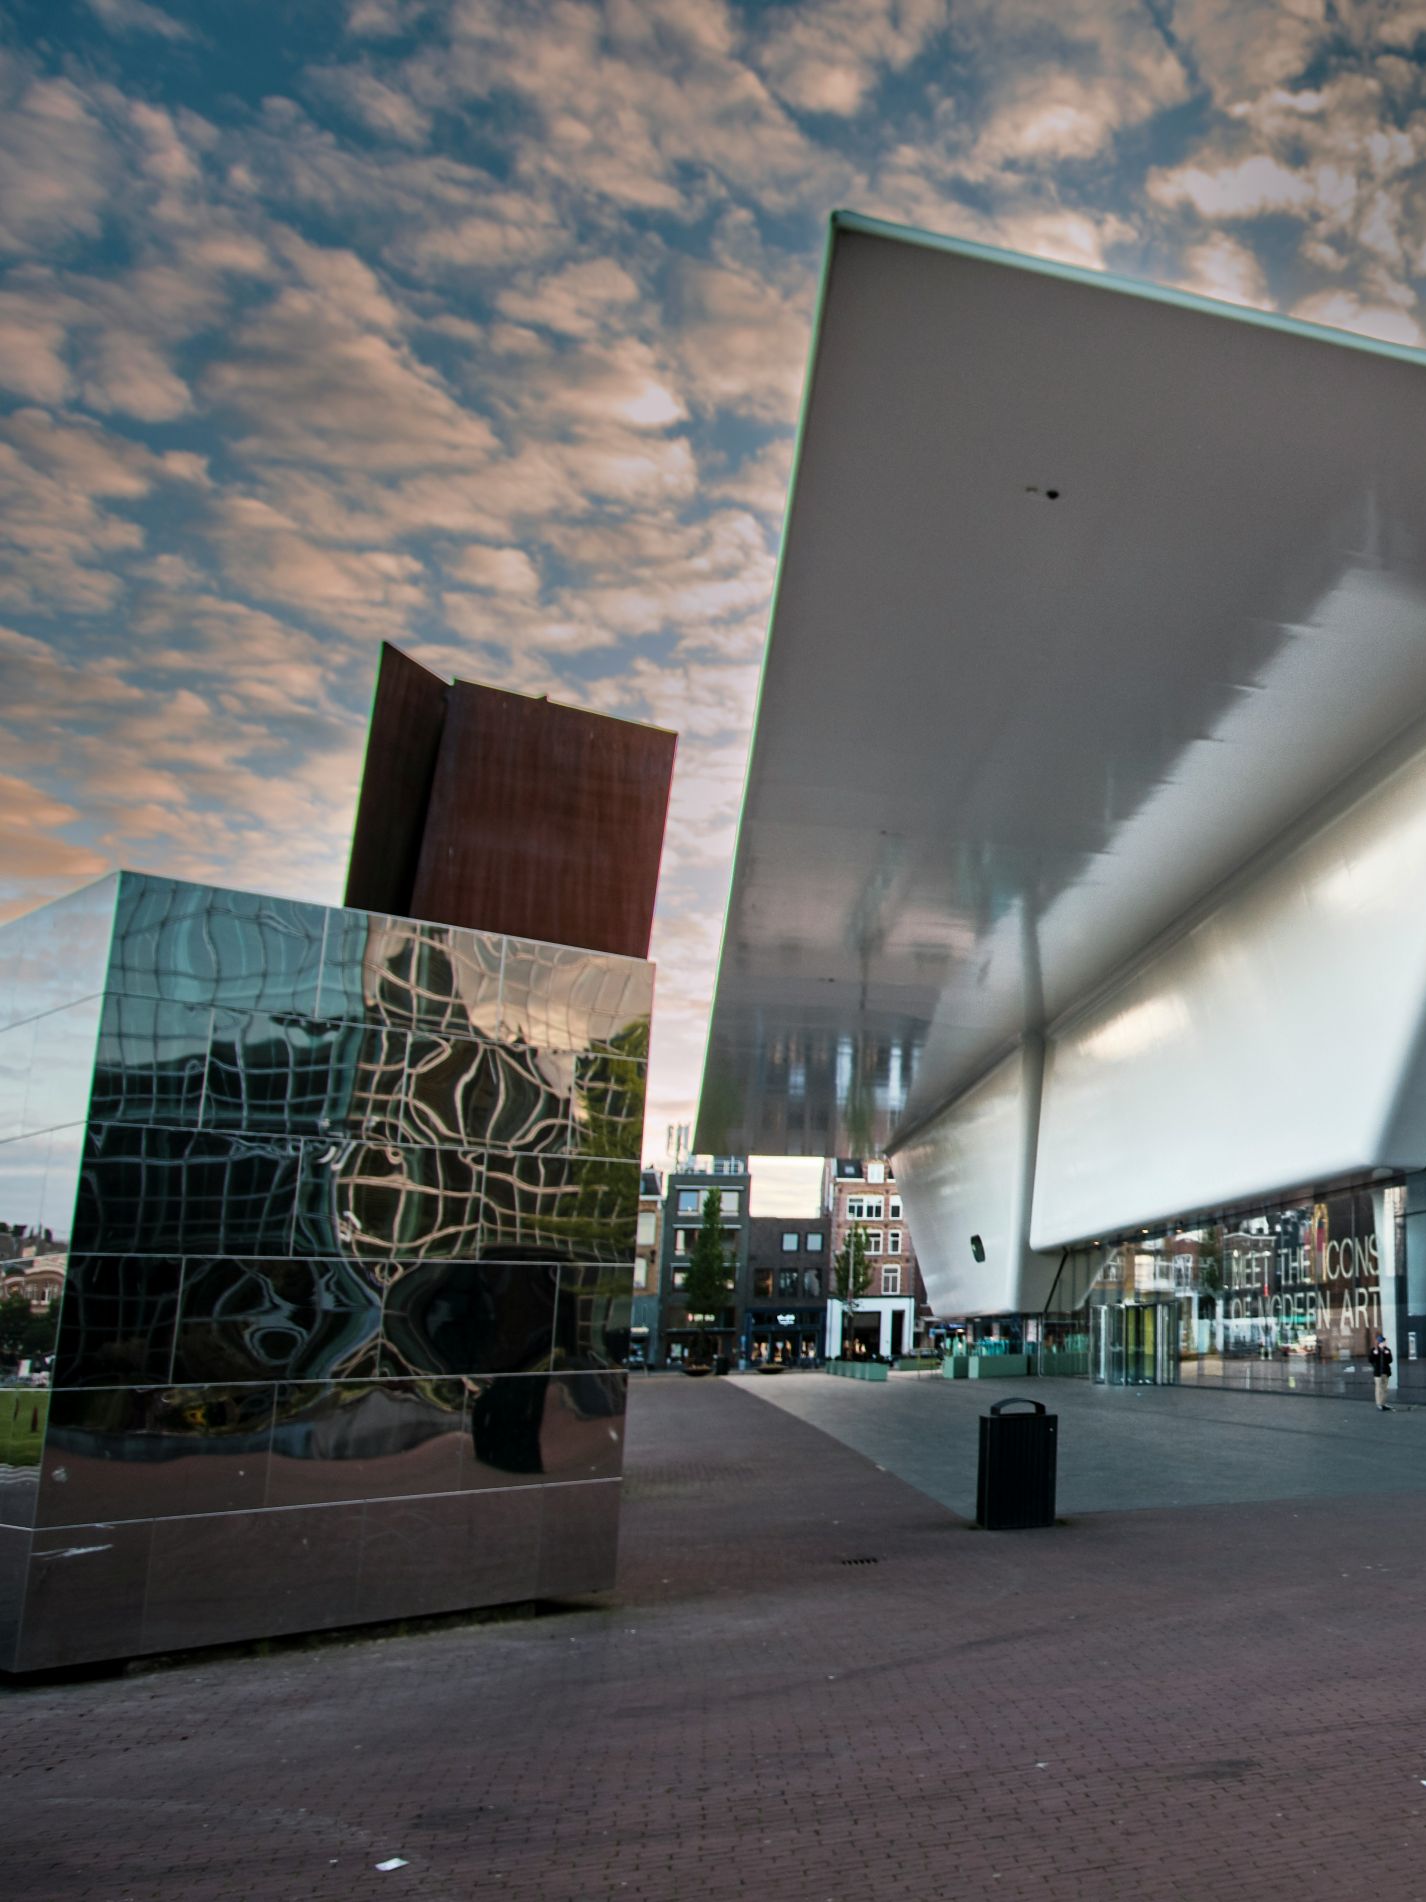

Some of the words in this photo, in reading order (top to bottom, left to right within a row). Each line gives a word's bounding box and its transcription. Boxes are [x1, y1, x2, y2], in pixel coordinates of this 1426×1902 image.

[1231, 1249, 1272, 1290] MEET
[1278, 1245, 1311, 1285] THE
[1322, 1234, 1379, 1281] ICONS
[1231, 1296, 1252, 1329] OF
[1257, 1290, 1331, 1330] MODERN
[1340, 1286, 1381, 1329] ART
